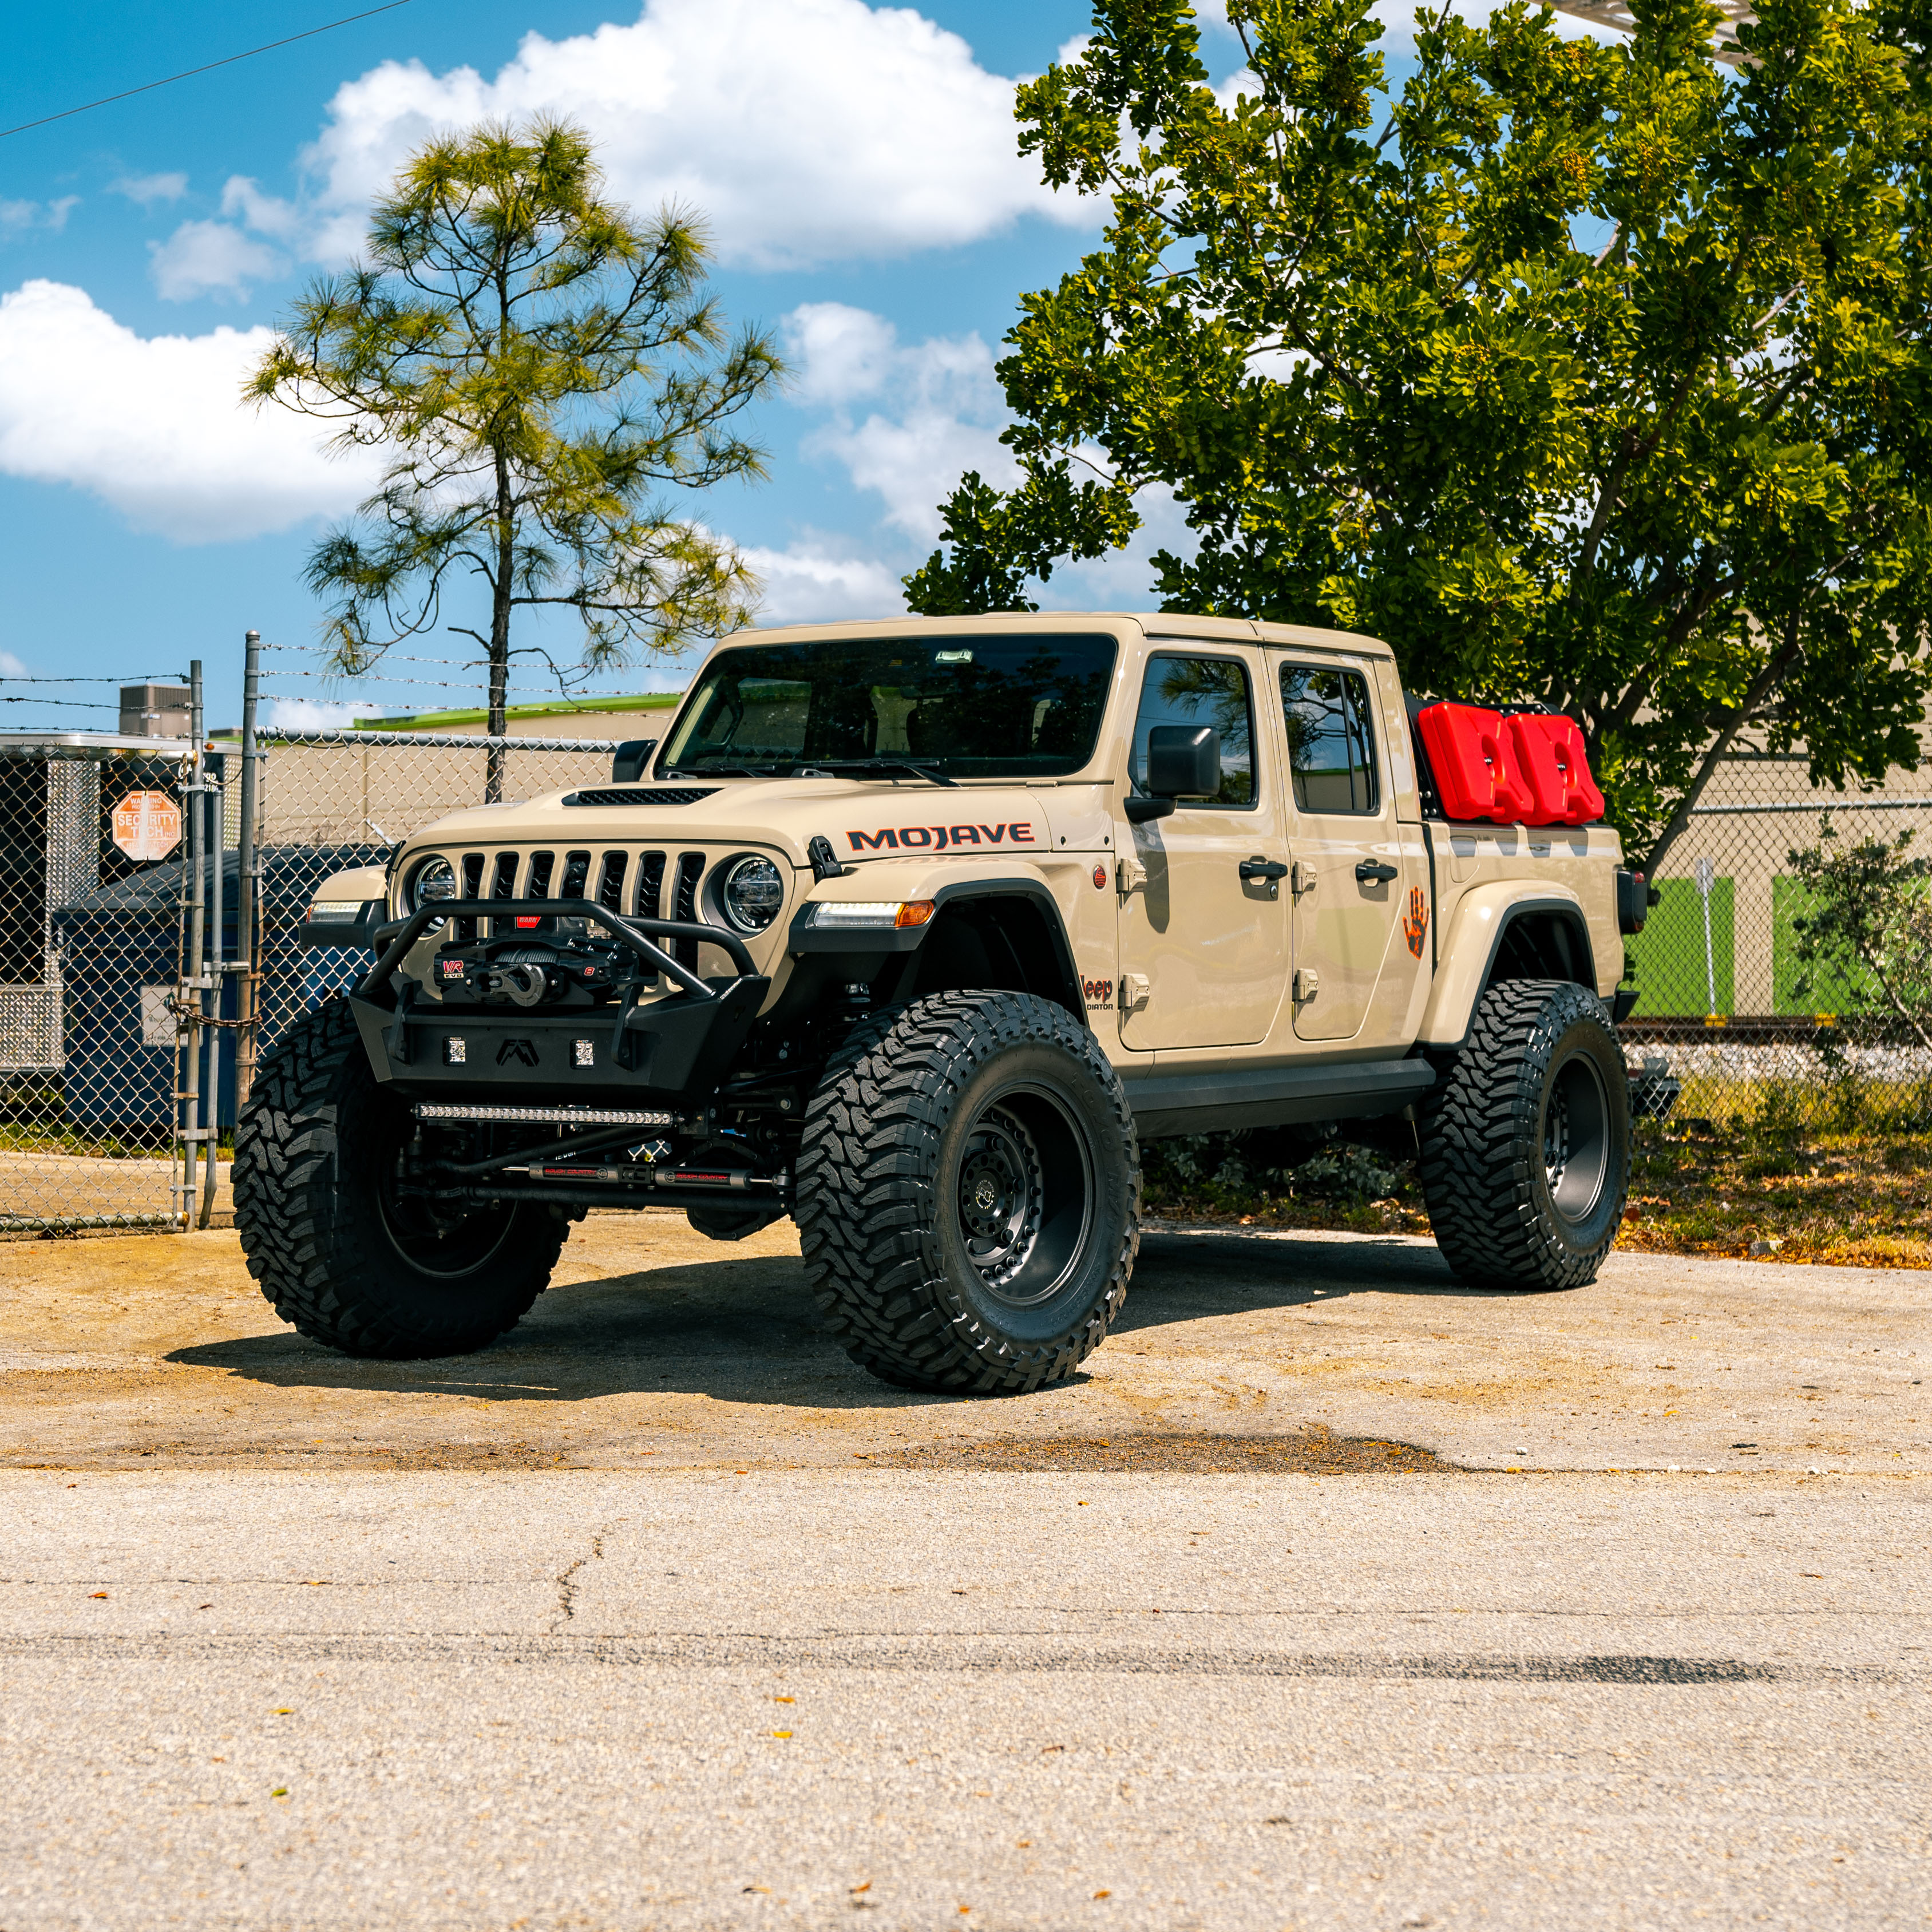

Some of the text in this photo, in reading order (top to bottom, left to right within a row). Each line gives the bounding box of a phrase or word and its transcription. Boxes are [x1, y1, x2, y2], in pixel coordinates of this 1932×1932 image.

[118, 814, 176, 826] SECRITY
[130, 826, 163, 838] TCH
[846, 822, 1035, 851] MOJAVE
[443, 960, 464, 973] VR
[584, 967, 595, 976] 8
